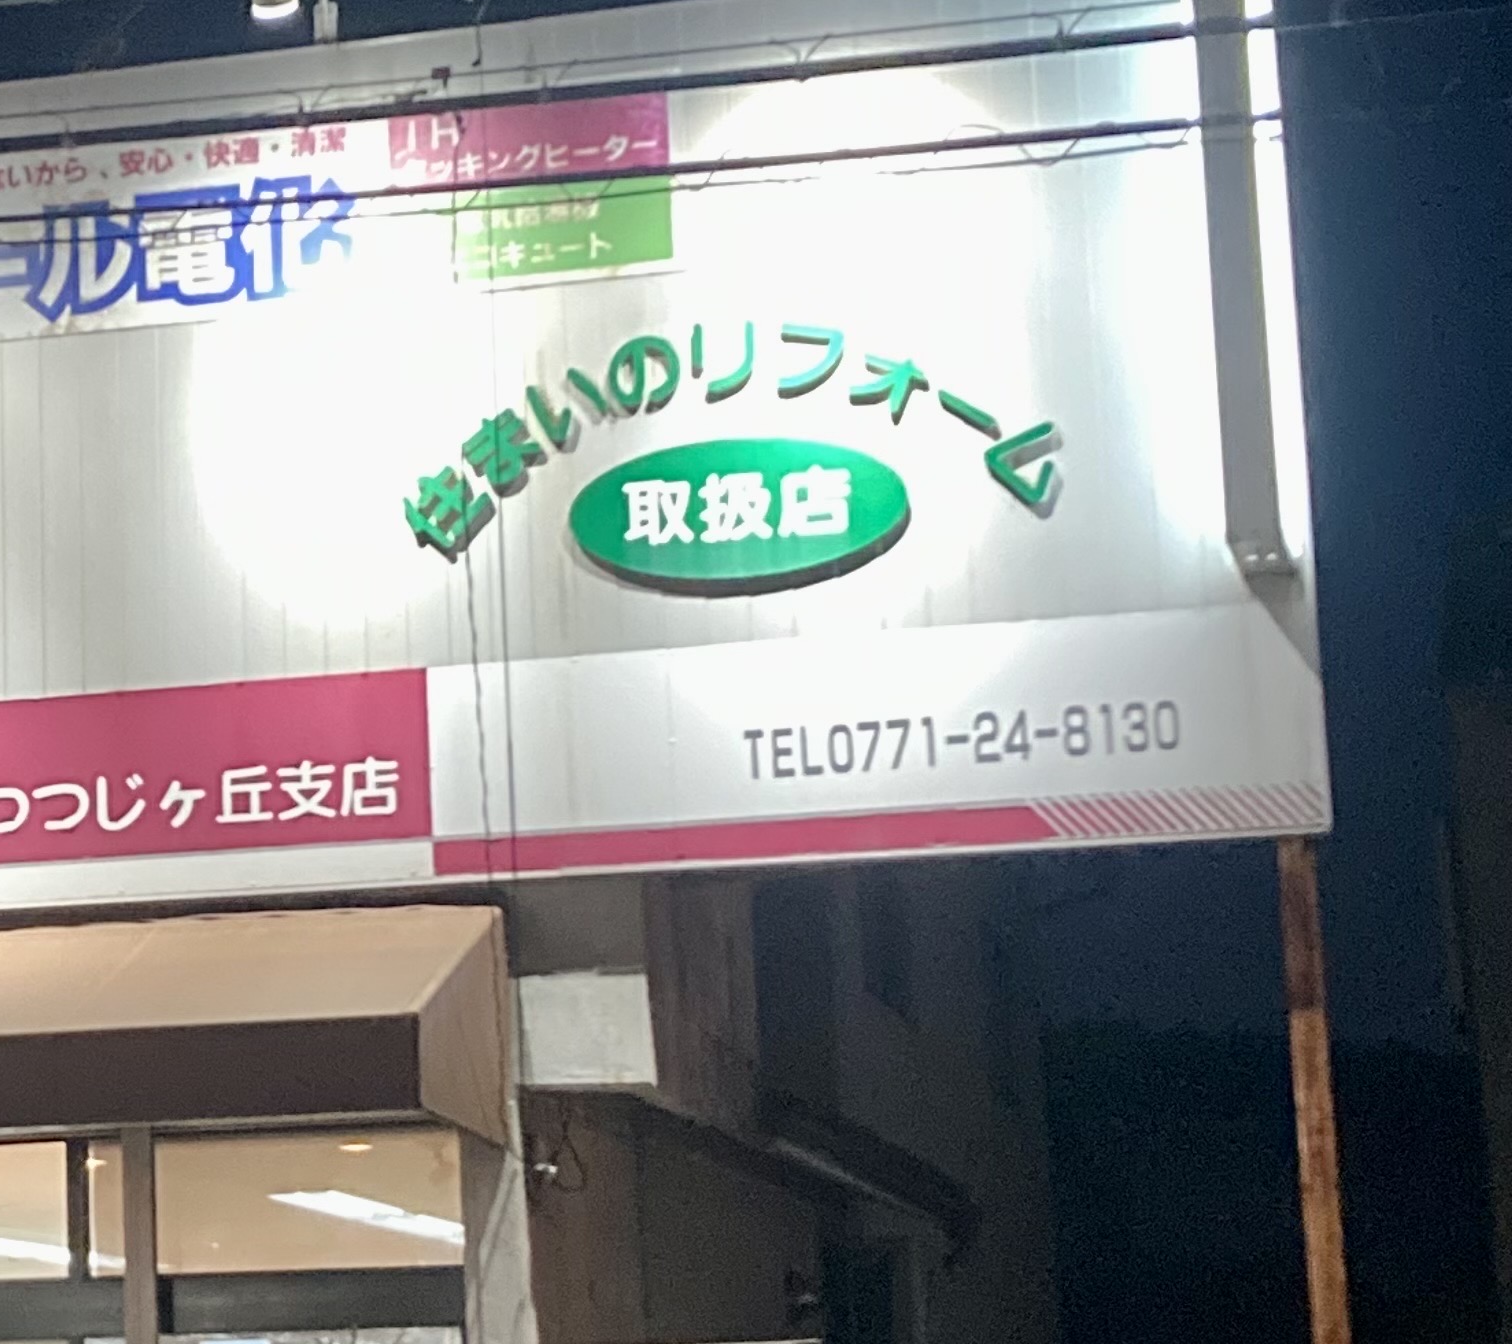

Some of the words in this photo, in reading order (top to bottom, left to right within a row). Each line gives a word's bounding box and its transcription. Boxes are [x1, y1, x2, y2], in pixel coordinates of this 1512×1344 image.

[402, 320, 1063, 562] 住まいのリフォーム
[622, 464, 853, 546] 取扱店
